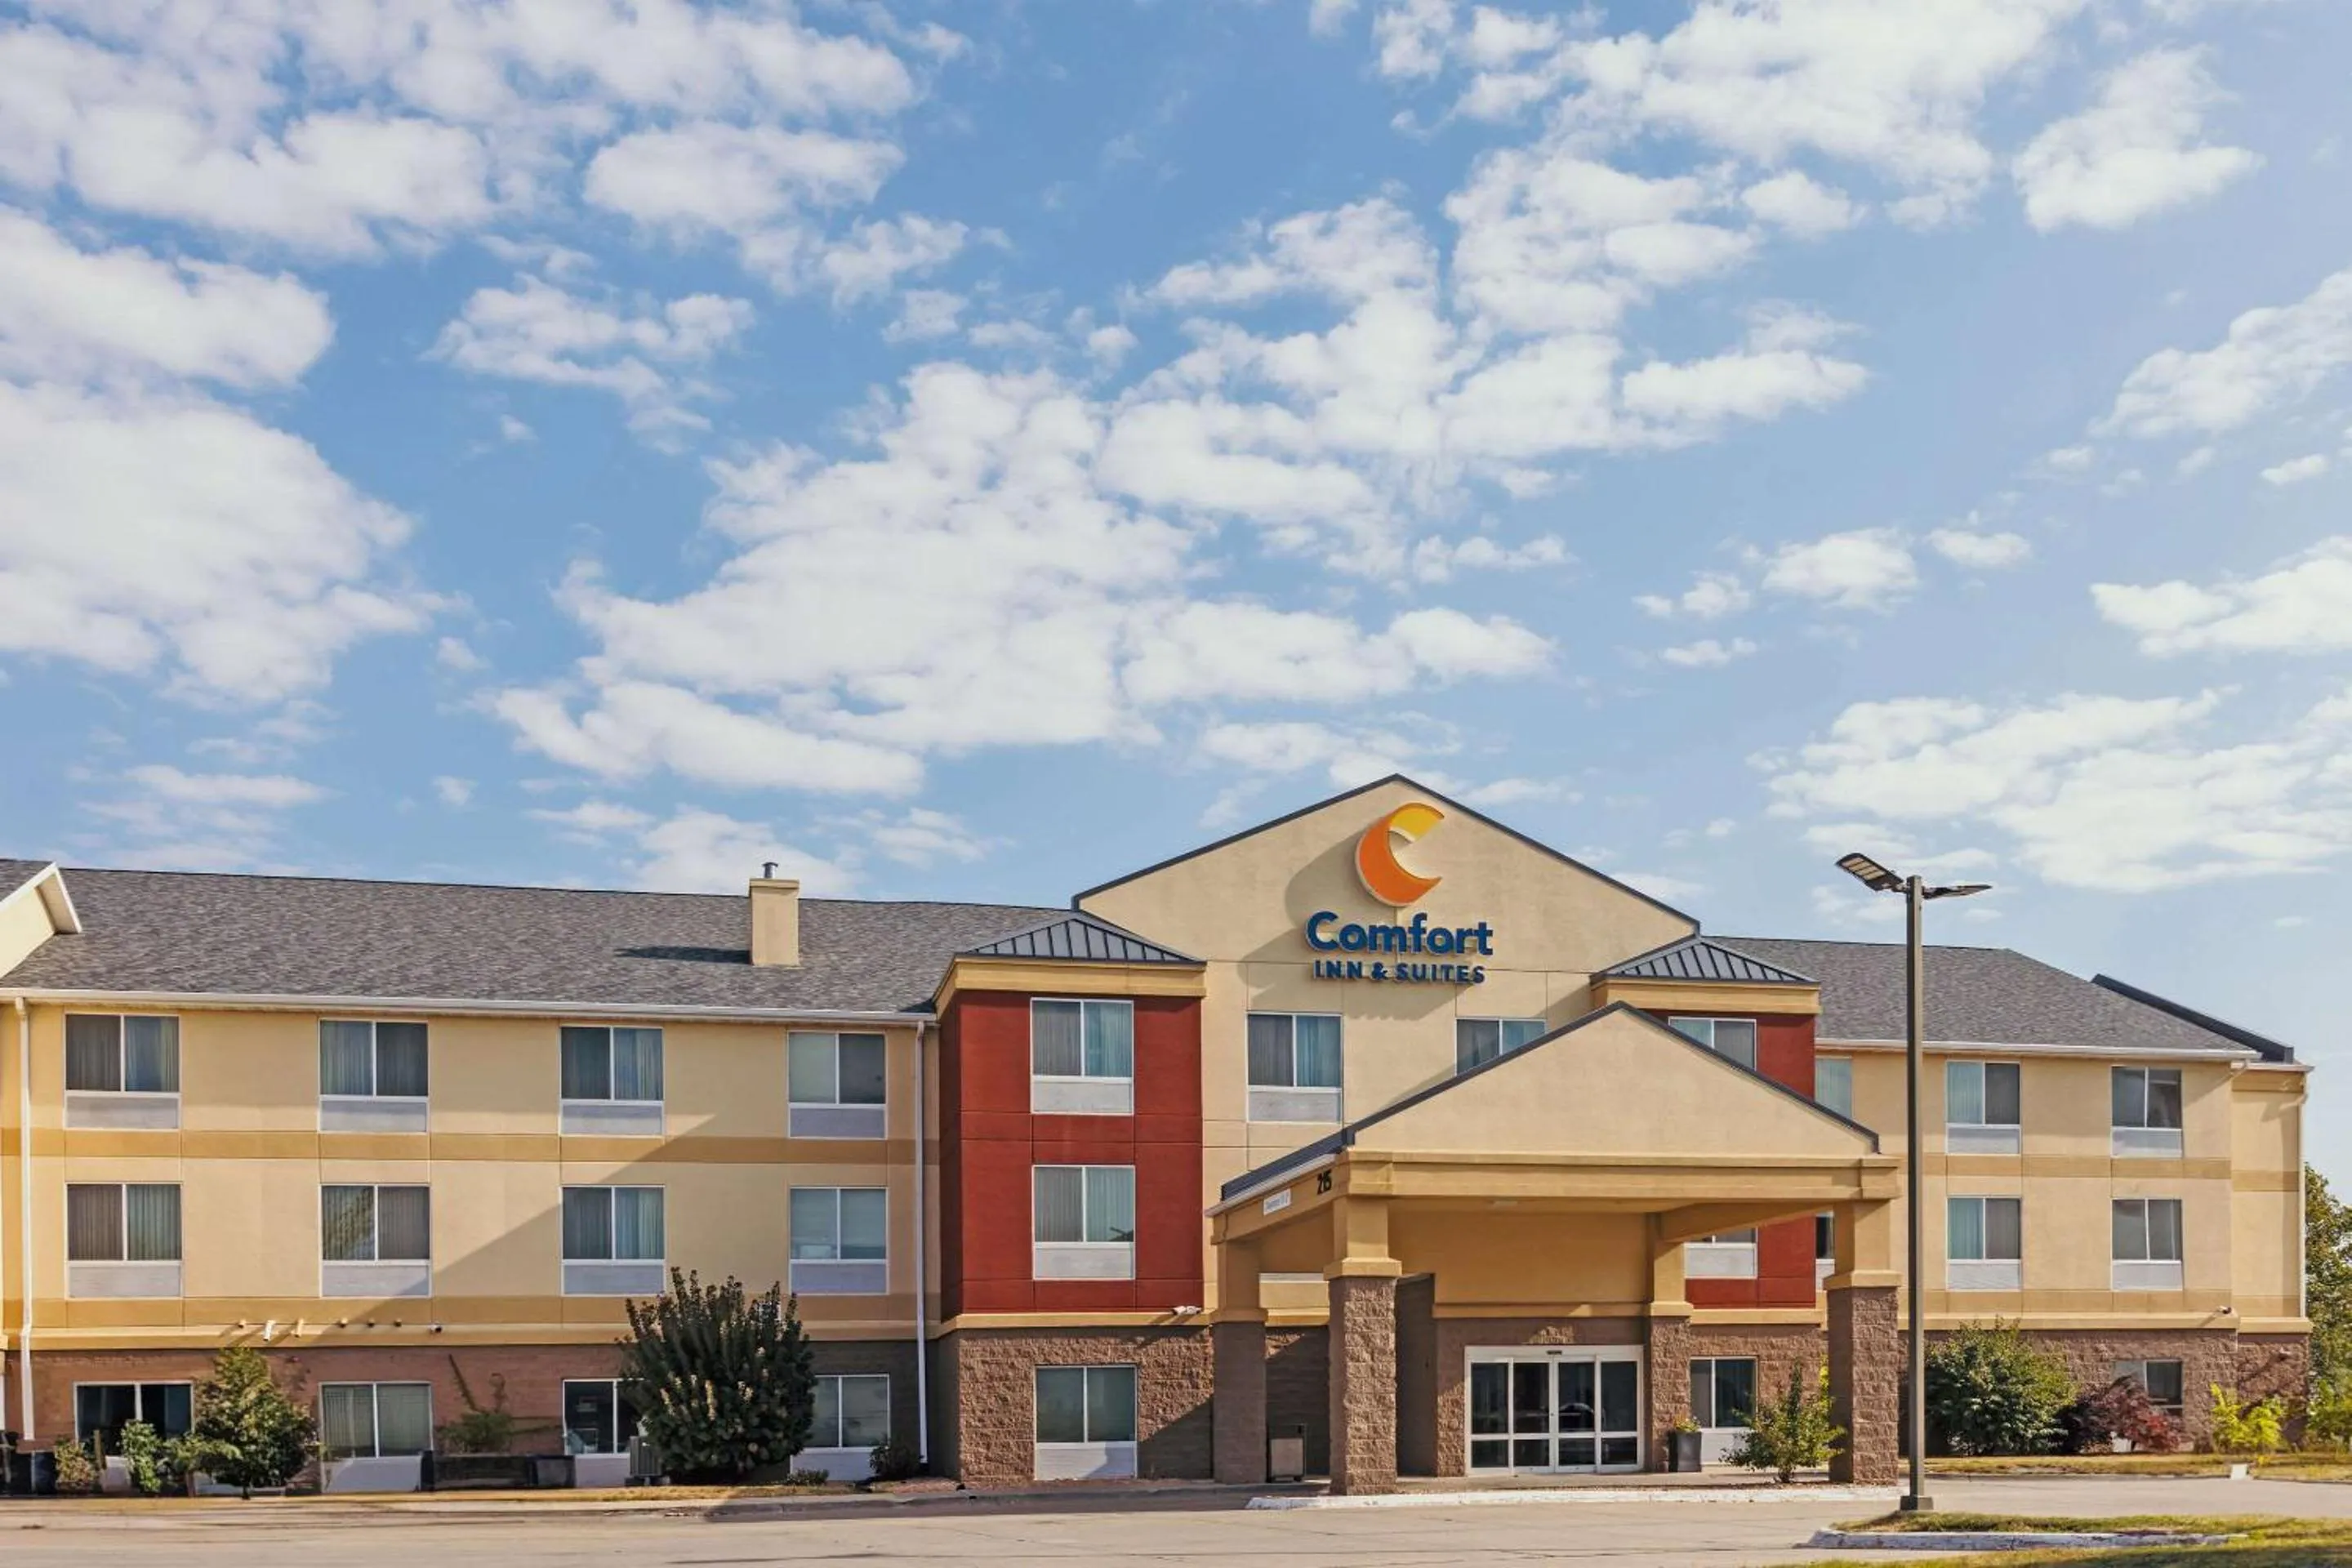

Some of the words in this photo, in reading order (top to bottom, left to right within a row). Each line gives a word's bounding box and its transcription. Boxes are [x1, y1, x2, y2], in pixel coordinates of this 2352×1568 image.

[1306, 911, 1494, 956] Comfort
[1313, 960, 1362, 980] INN
[1371, 962, 1388, 981] &
[1396, 963, 1486, 984] SUITES
